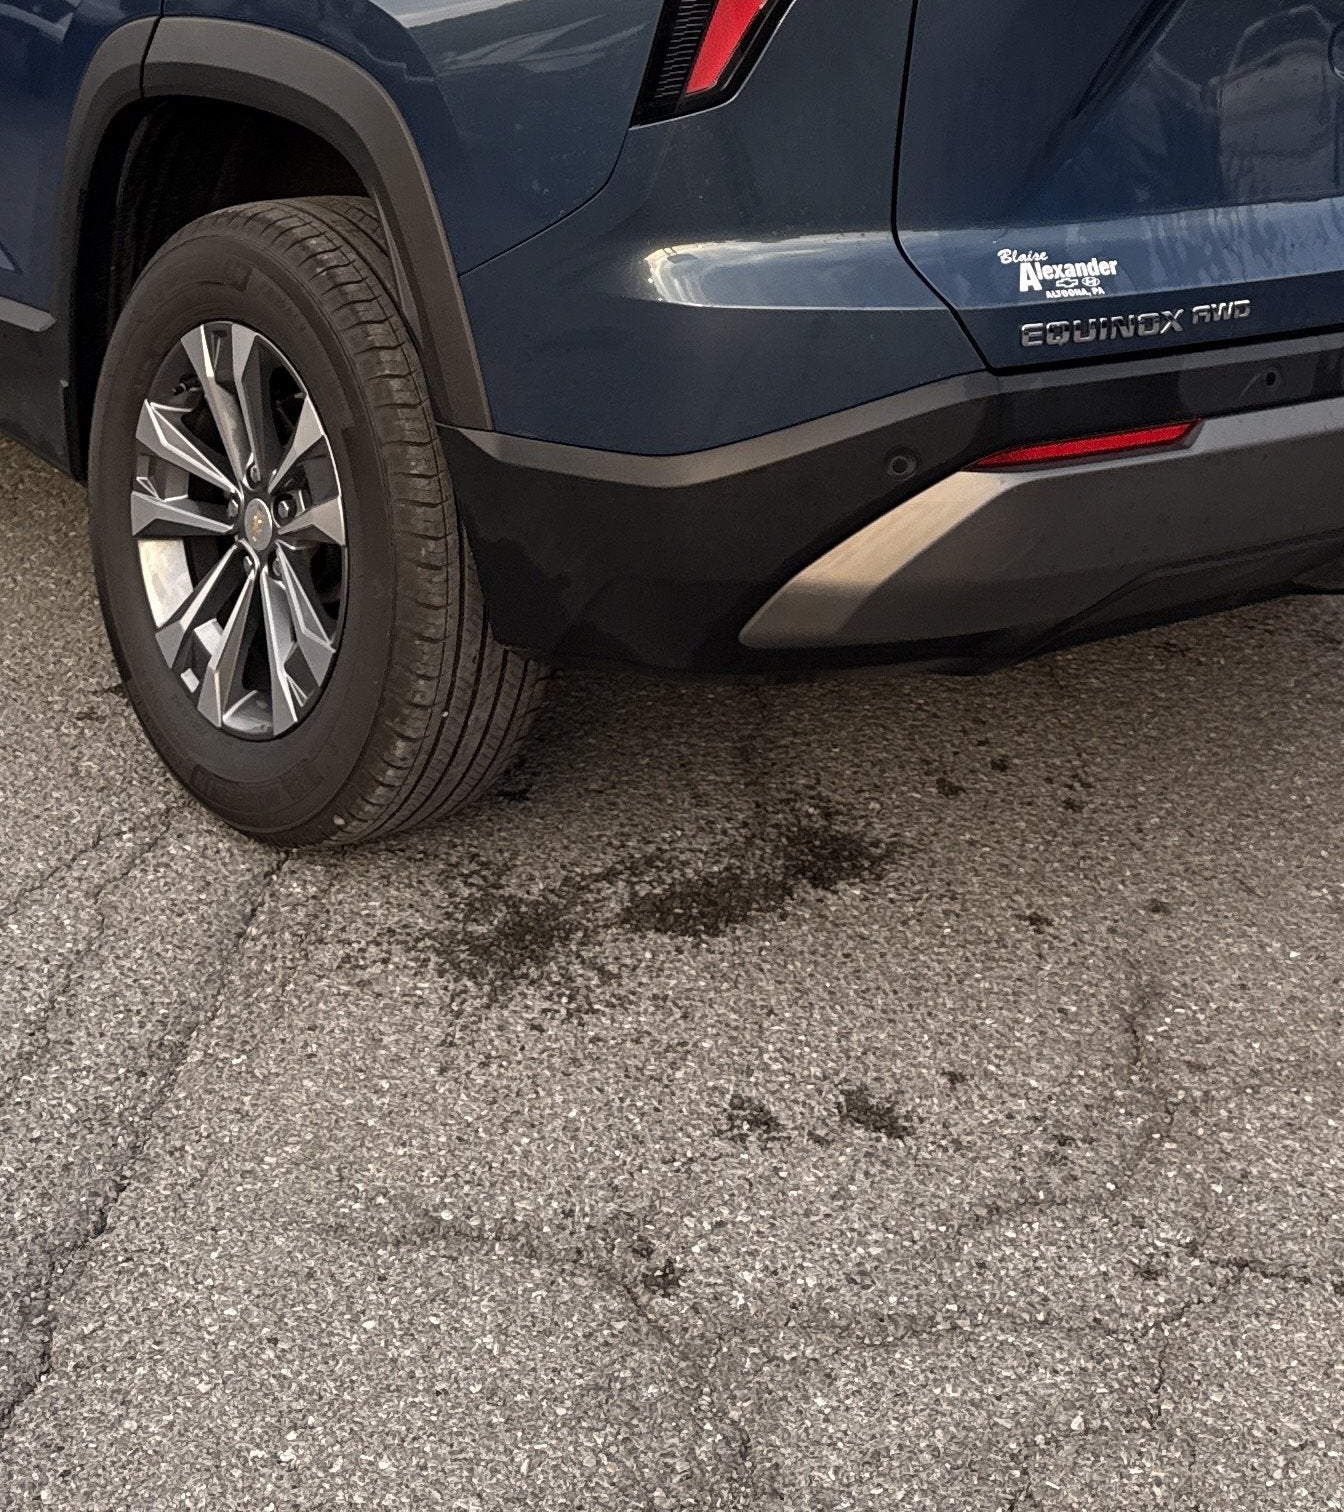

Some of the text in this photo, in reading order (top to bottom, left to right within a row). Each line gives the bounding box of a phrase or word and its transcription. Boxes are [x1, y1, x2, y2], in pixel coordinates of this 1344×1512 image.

[996, 248, 1049, 265] Blaise
[1018, 257, 1119, 293] Alexander
[1092, 285, 1106, 297] PA
[1019, 298, 1252, 348] EQUINOX AWD
